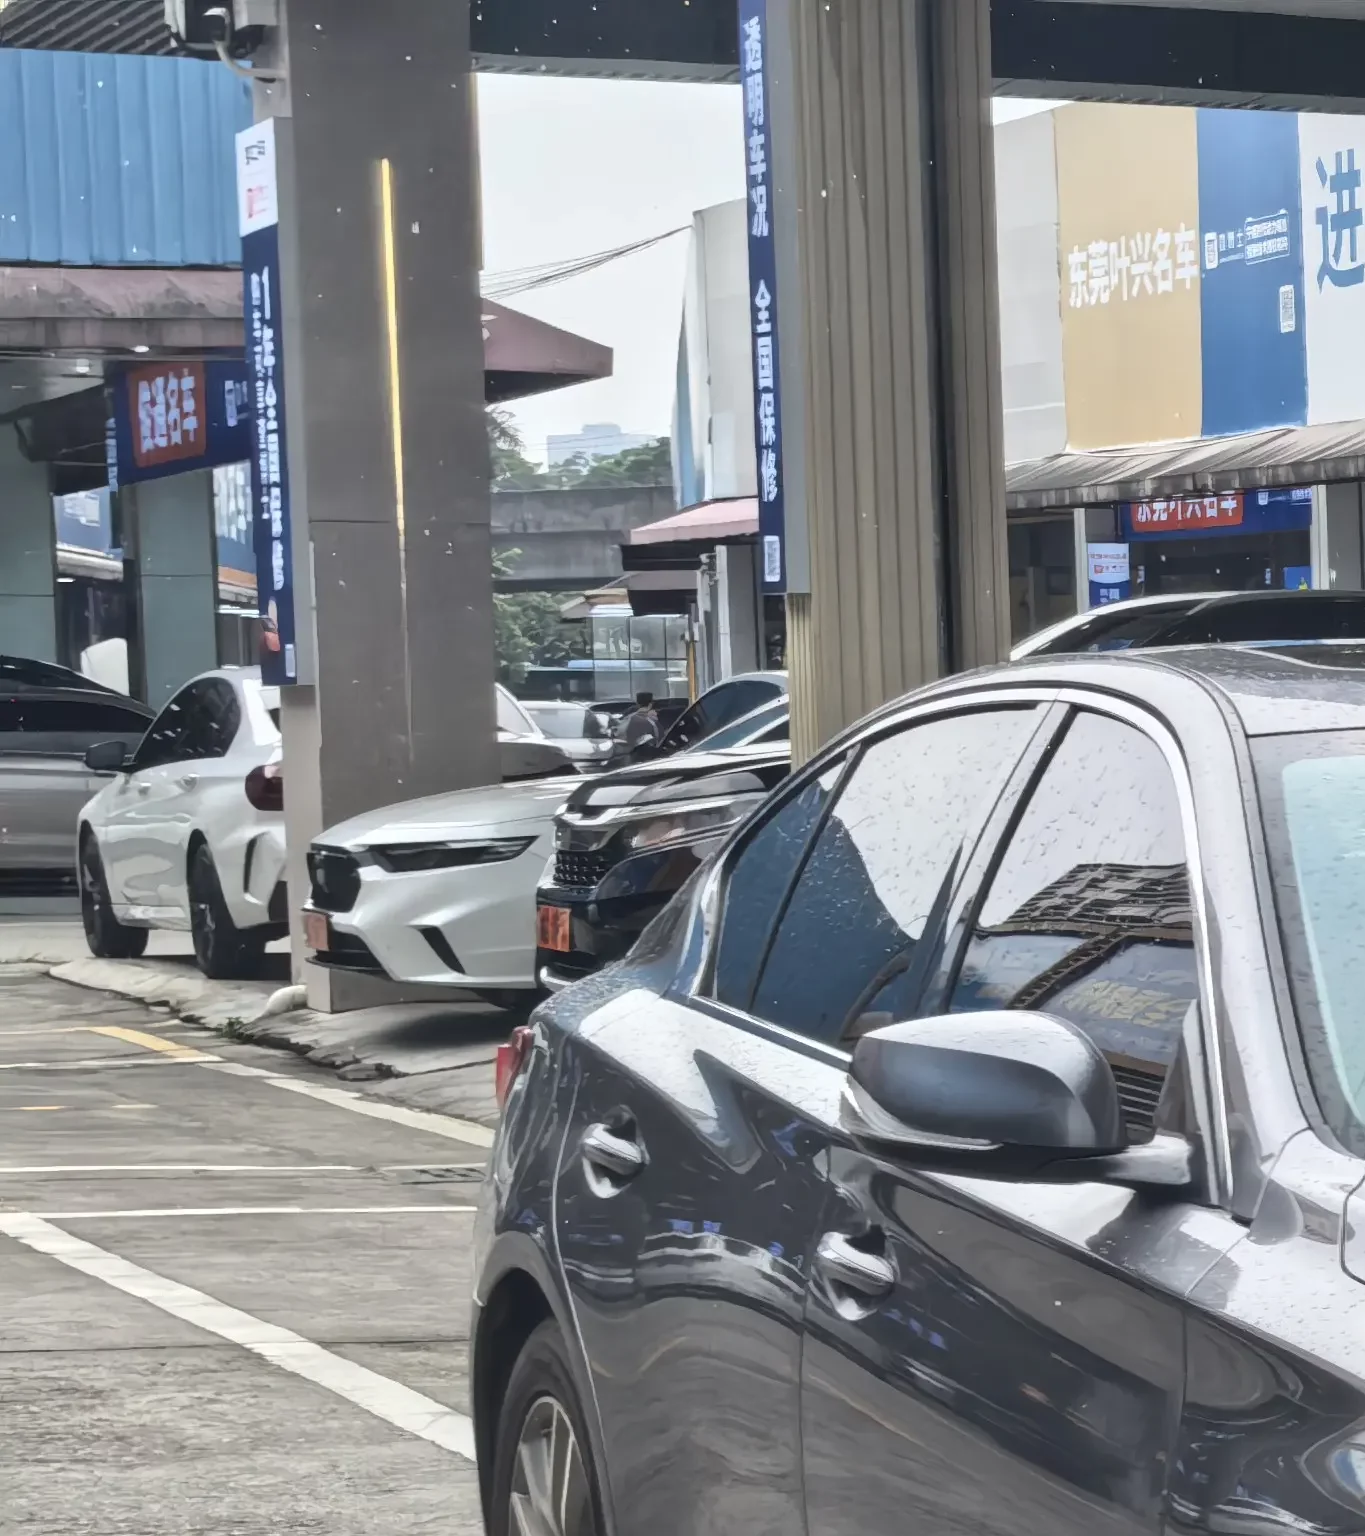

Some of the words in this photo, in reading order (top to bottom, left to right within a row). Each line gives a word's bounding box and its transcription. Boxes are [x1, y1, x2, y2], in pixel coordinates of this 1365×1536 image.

[743, 16, 769, 237] 透明车况
[1068, 222, 1198, 308] 东莞叶兴名车
[755, 279, 777, 502] 全国保修
